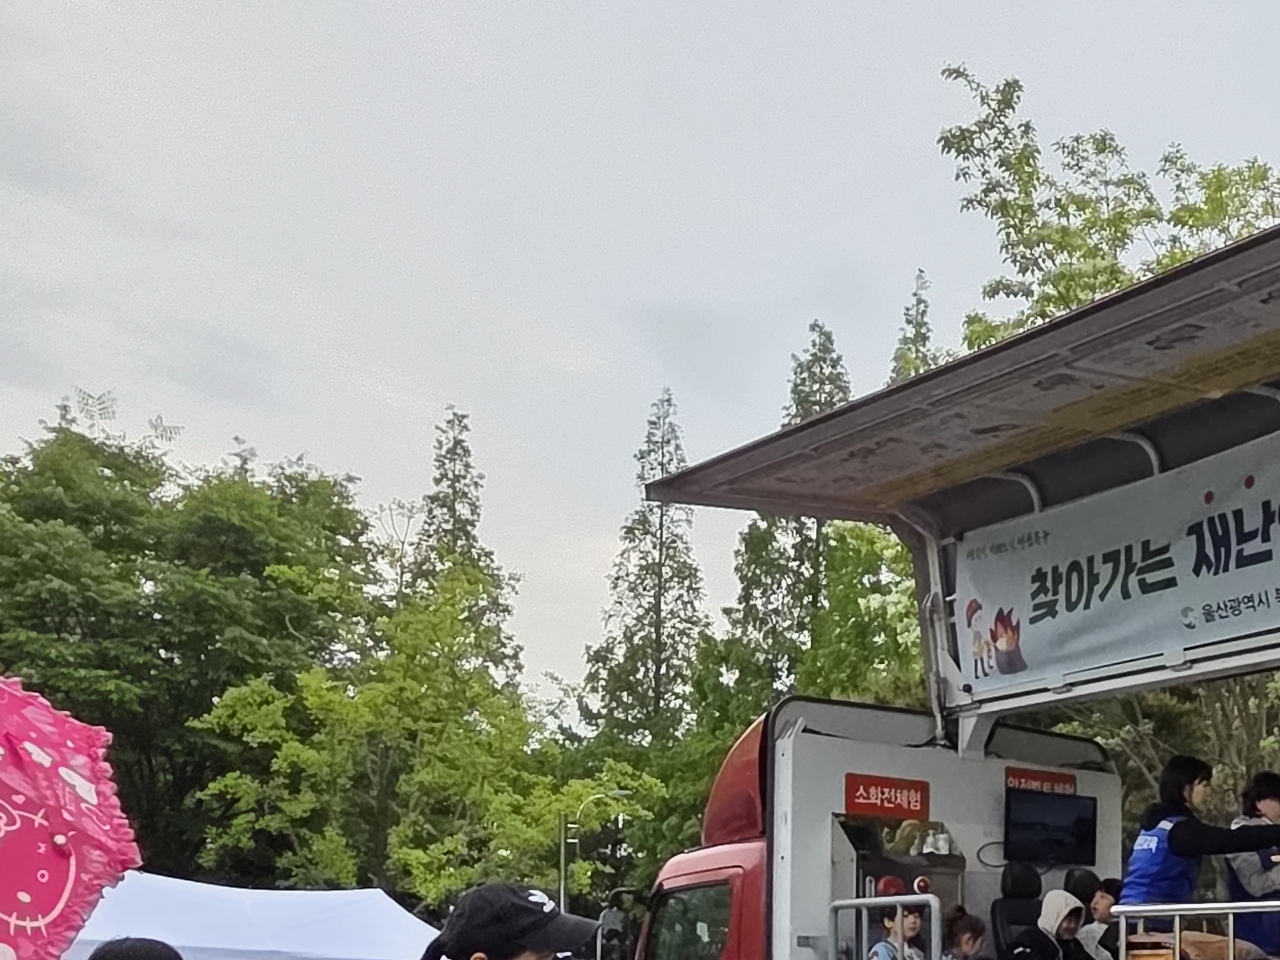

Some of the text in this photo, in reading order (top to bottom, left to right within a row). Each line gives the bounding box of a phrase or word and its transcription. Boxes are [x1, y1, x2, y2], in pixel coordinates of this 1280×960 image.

[1029, 539, 1178, 625] 찾아가는
[1201, 590, 1270, 623] 울산광역시
[854, 785, 922, 811] 소화전체험
